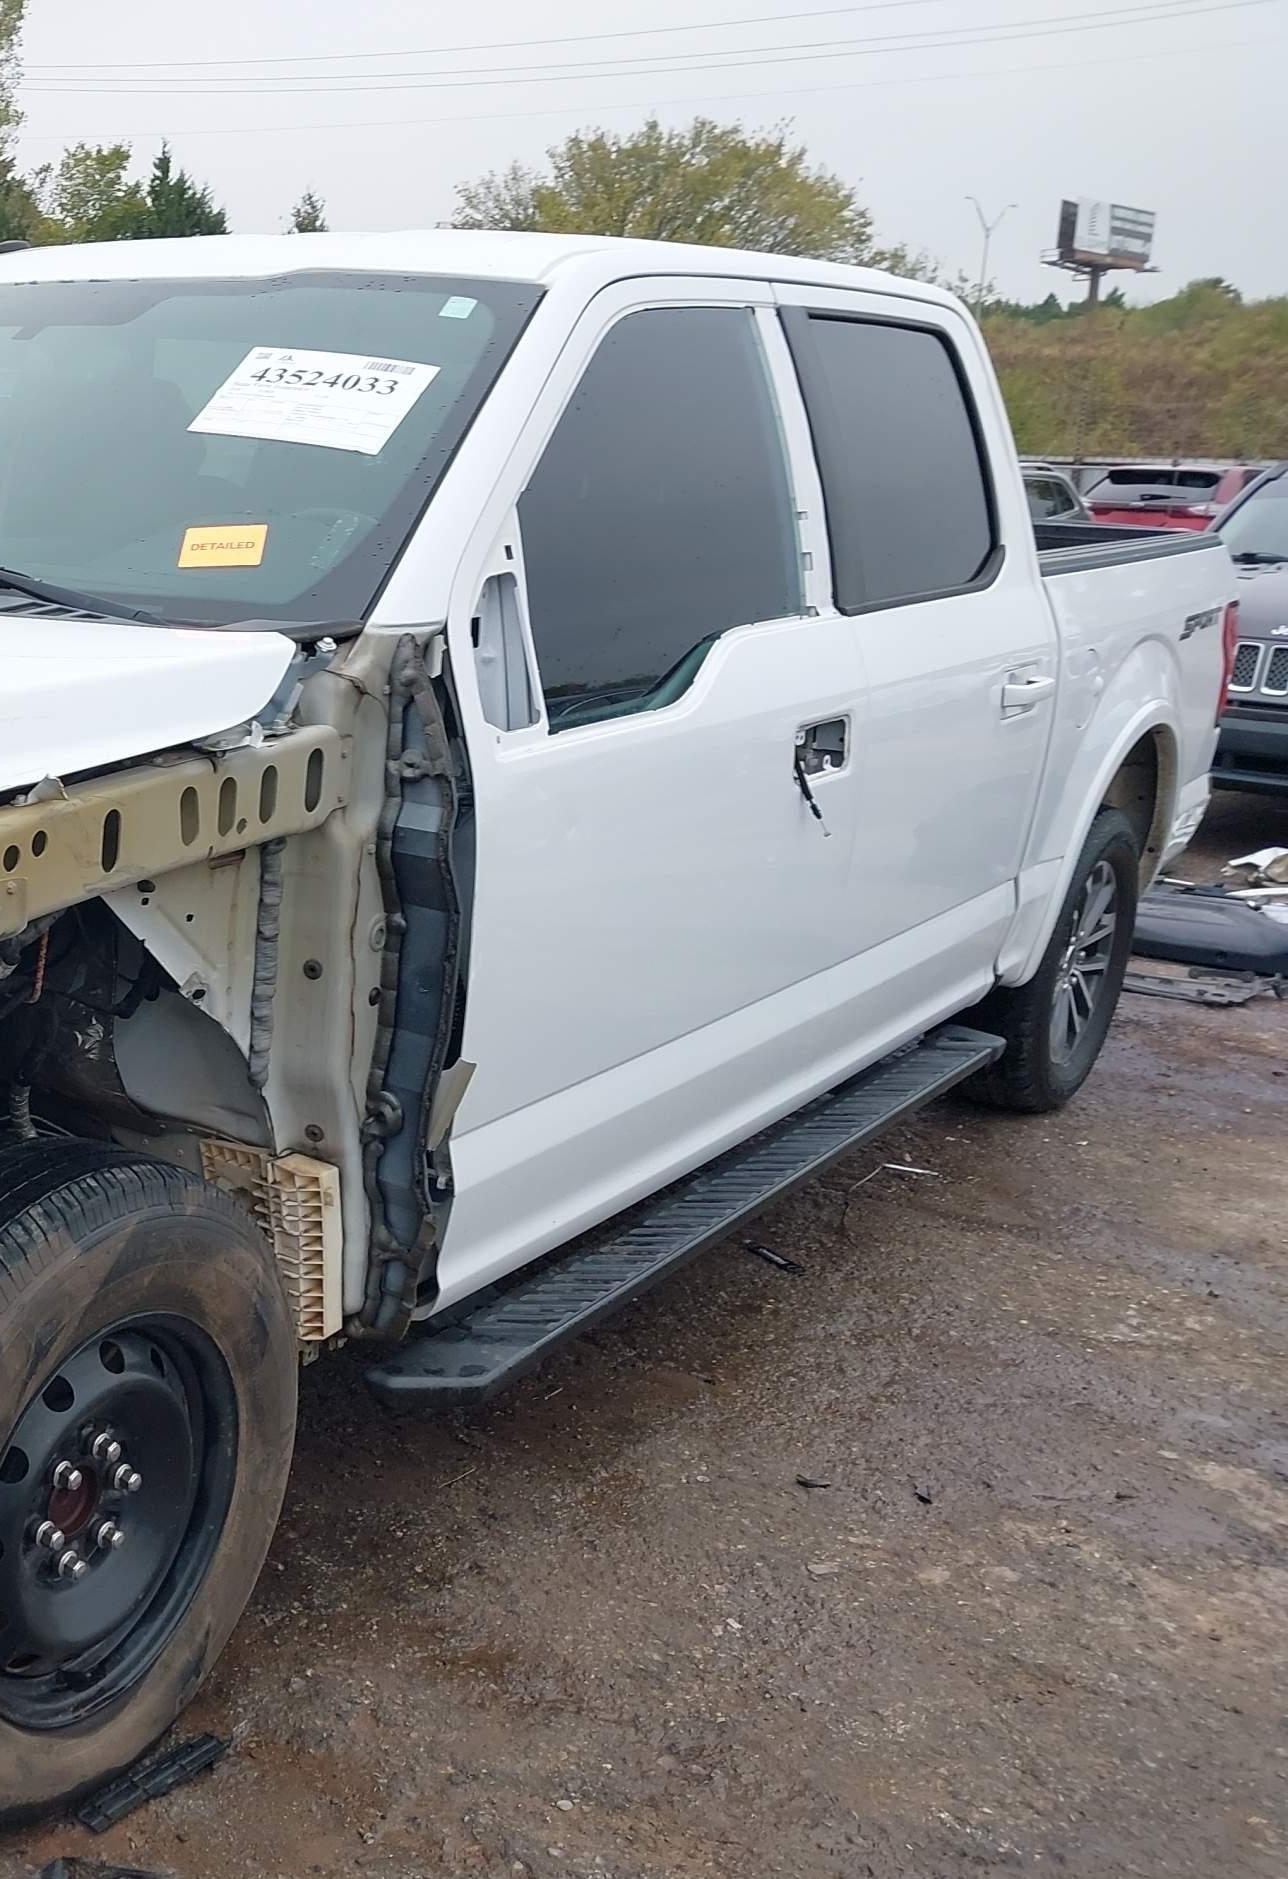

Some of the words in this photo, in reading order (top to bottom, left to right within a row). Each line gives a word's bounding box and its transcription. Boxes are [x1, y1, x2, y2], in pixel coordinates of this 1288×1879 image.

[250, 367, 399, 396] 43524033
[191, 541, 255, 551] DETAILED
[1178, 606, 1223, 641] SPORT
